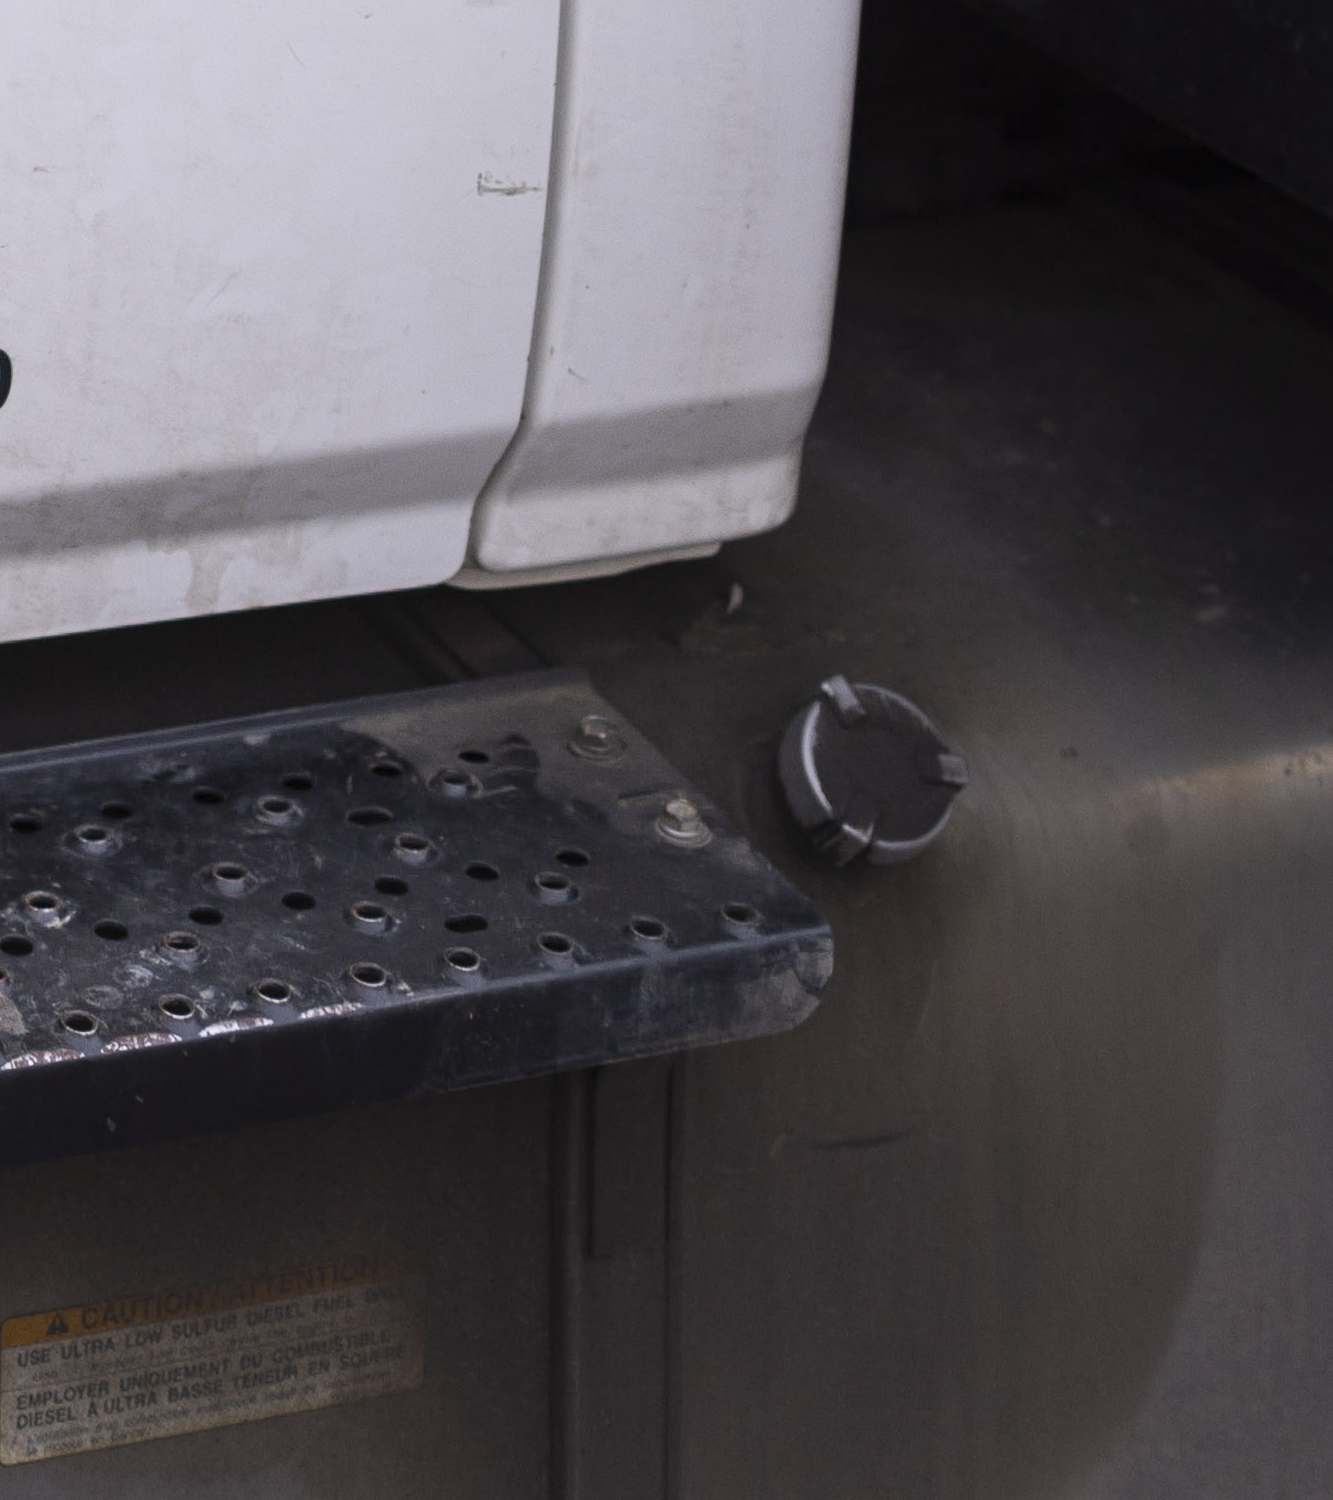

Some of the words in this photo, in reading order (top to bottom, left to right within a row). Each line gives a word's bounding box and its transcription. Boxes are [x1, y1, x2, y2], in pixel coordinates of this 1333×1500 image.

[17, 1348, 50, 1368] USE
[62, 1337, 115, 1360] ULTRA
[126, 1329, 161, 1347] LOW
[171, 1314, 237, 1339] SULFUR
[245, 1304, 304, 1326] DIESEL
[82, 1292, 202, 1329] CAUTION
[17, 1381, 109, 1410] EMPLOYER
[120, 1358, 230, 1392] UNIQUEMENT
[239, 1354, 262, 1370] DU
[271, 1330, 390, 1363] COMBUSTIBLE
[17, 1406, 76, 1429] DIESEL
[104, 1393, 157, 1413] ULTRA
[168, 1382, 223, 1403] BASSE
[232, 1366, 297, 1389] TENEUR
[308, 1359, 329, 1375] EN
